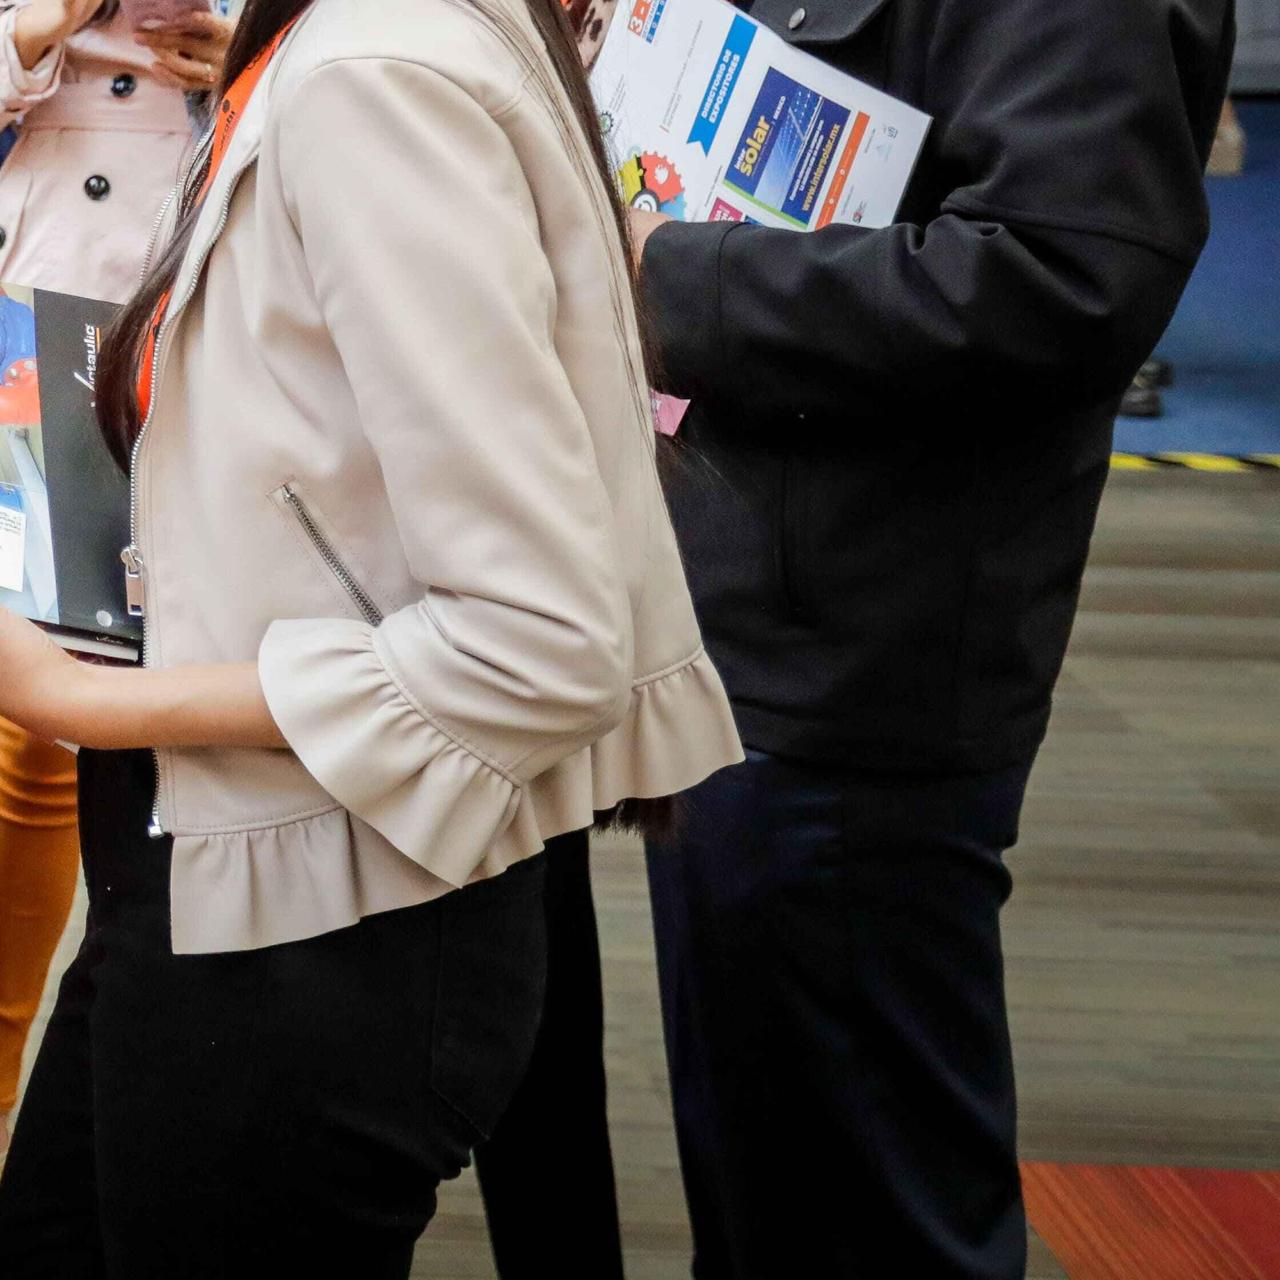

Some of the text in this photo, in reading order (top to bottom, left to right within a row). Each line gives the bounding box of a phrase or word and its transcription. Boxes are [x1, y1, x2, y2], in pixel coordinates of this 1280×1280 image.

[701, 48, 732, 119] DIRECTORIO DE
[709, 53, 740, 124] EXPOSITORES
[741, 115, 770, 177] solar
[802, 123, 841, 211] www.intersolar.mx
